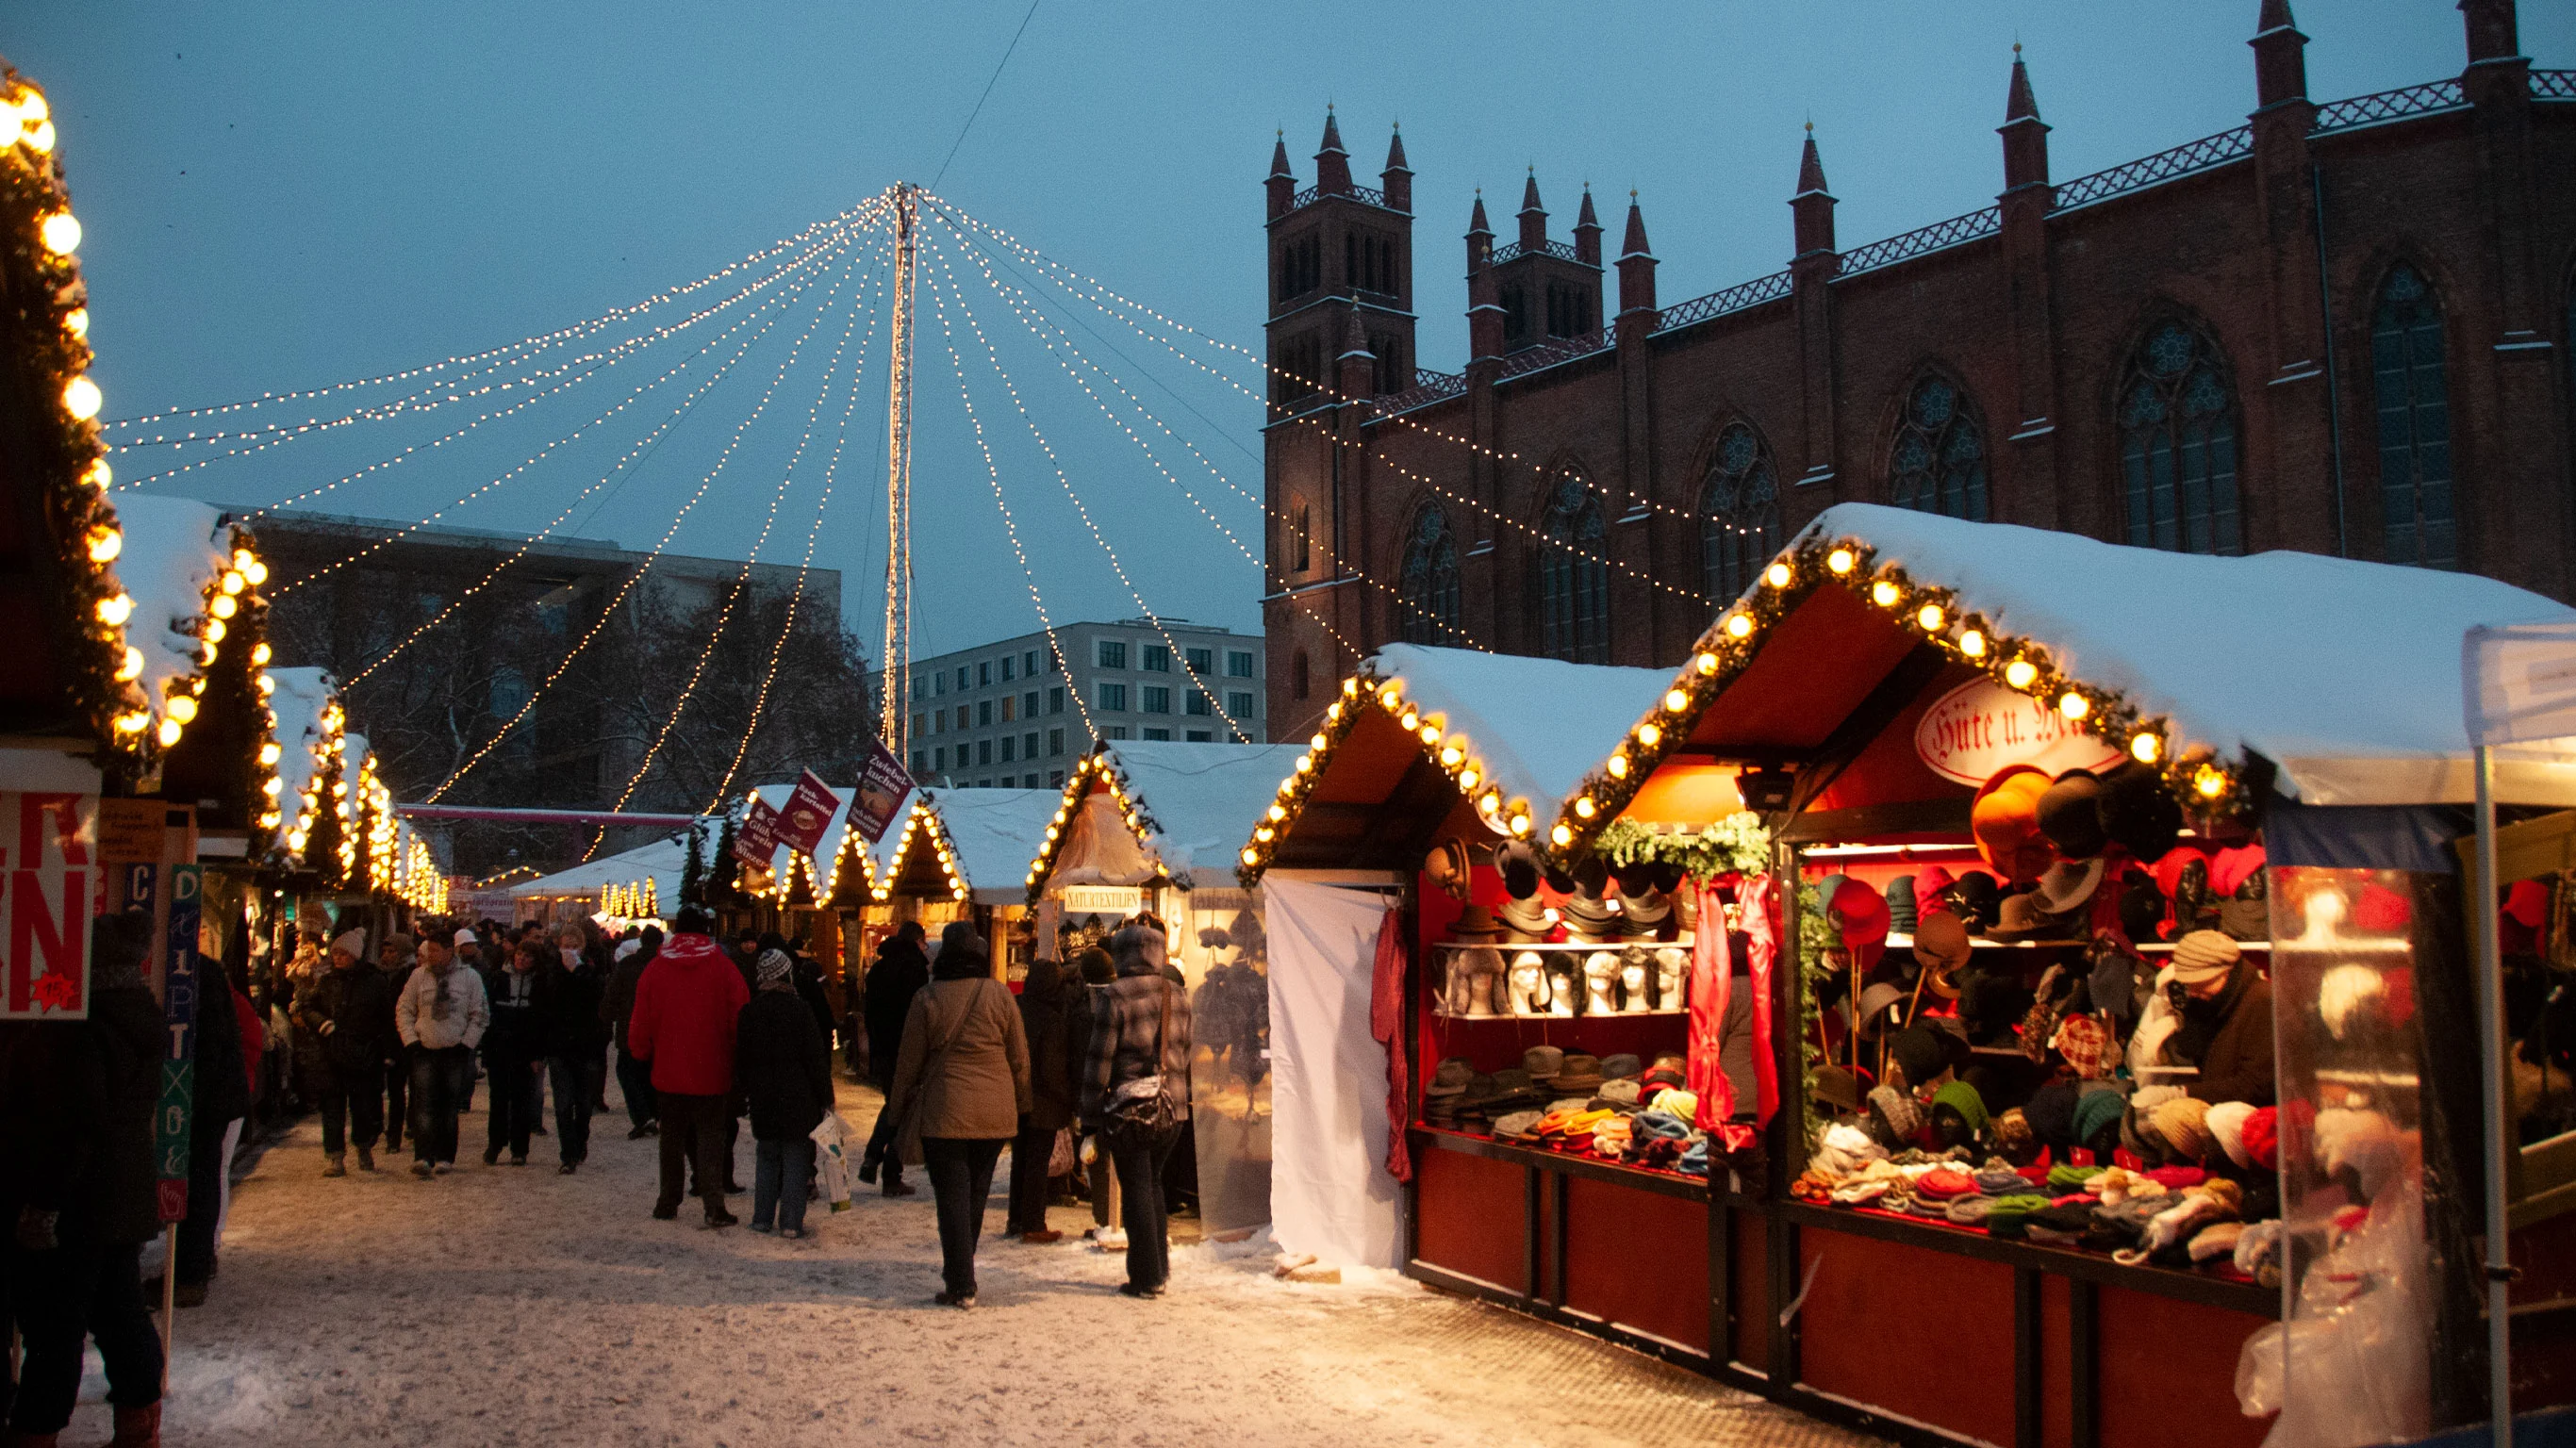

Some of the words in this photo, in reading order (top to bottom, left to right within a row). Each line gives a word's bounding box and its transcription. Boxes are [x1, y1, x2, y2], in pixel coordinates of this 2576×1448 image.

[1932, 699, 1993, 765] Hüte
[866, 765, 900, 795] kuchen
[868, 753, 908, 786] Zwiebel-
[1067, 891, 1138, 909] NATURTEXTILIEN
